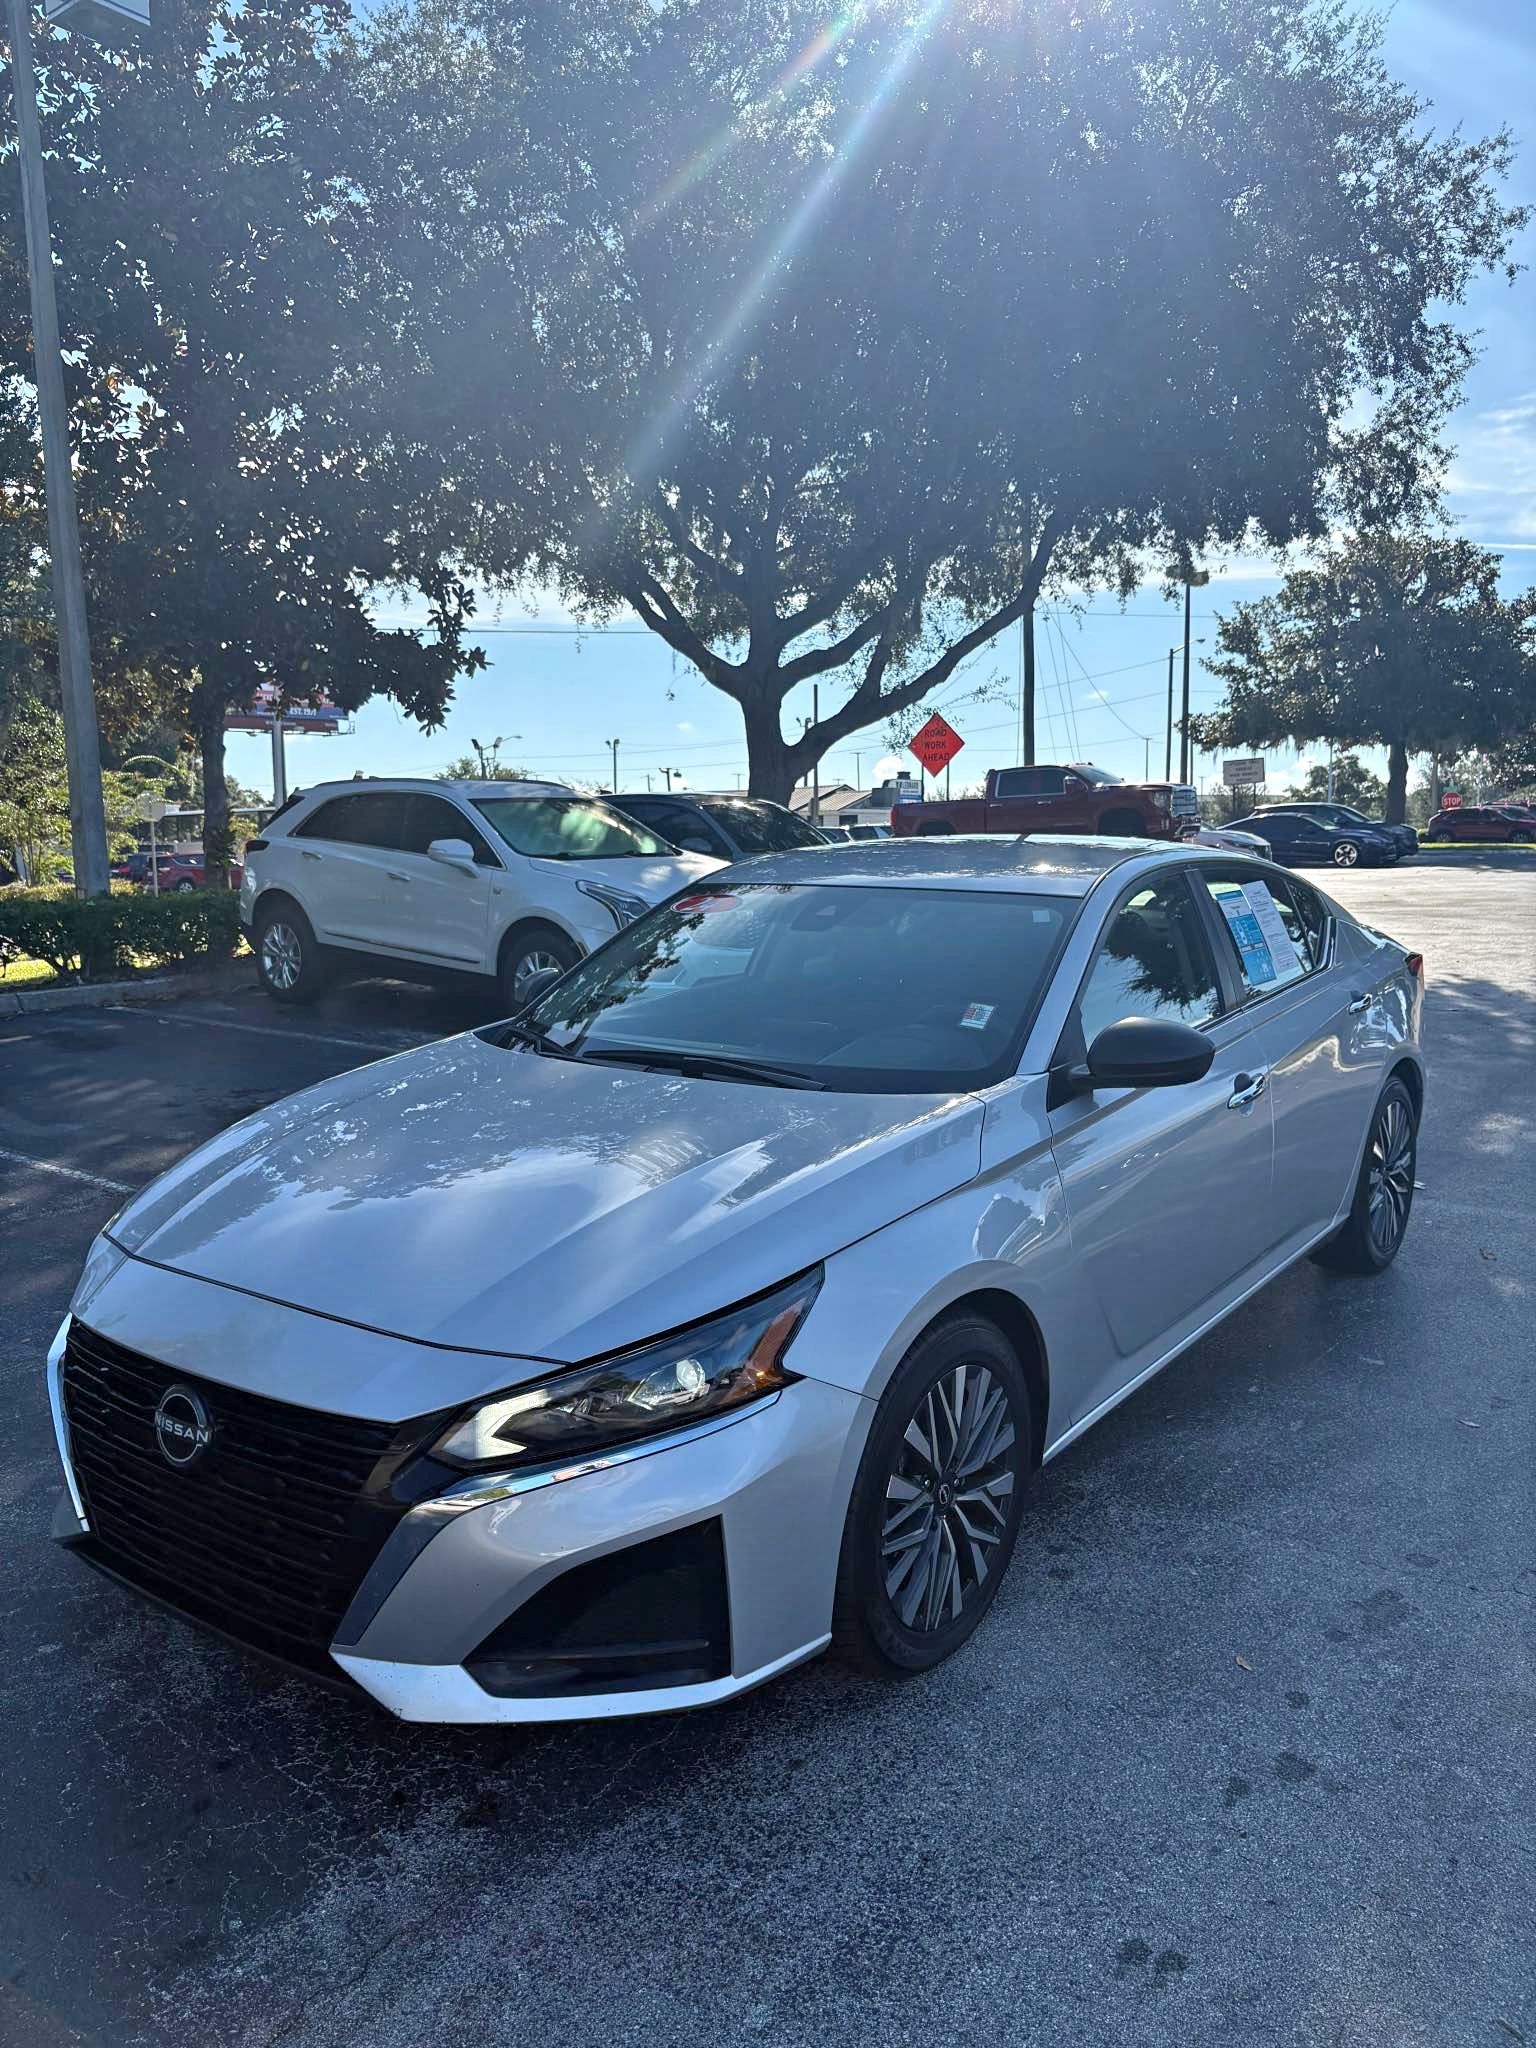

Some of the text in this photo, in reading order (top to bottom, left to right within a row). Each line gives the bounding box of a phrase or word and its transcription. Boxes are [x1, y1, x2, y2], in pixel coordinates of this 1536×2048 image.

[924, 729, 947, 737] ROAD
[924, 740, 946, 749] WORK
[923, 753, 950, 761] AHEAD
[1443, 797, 1461, 806] STOP
[155, 1410, 209, 1443] NISSAN
